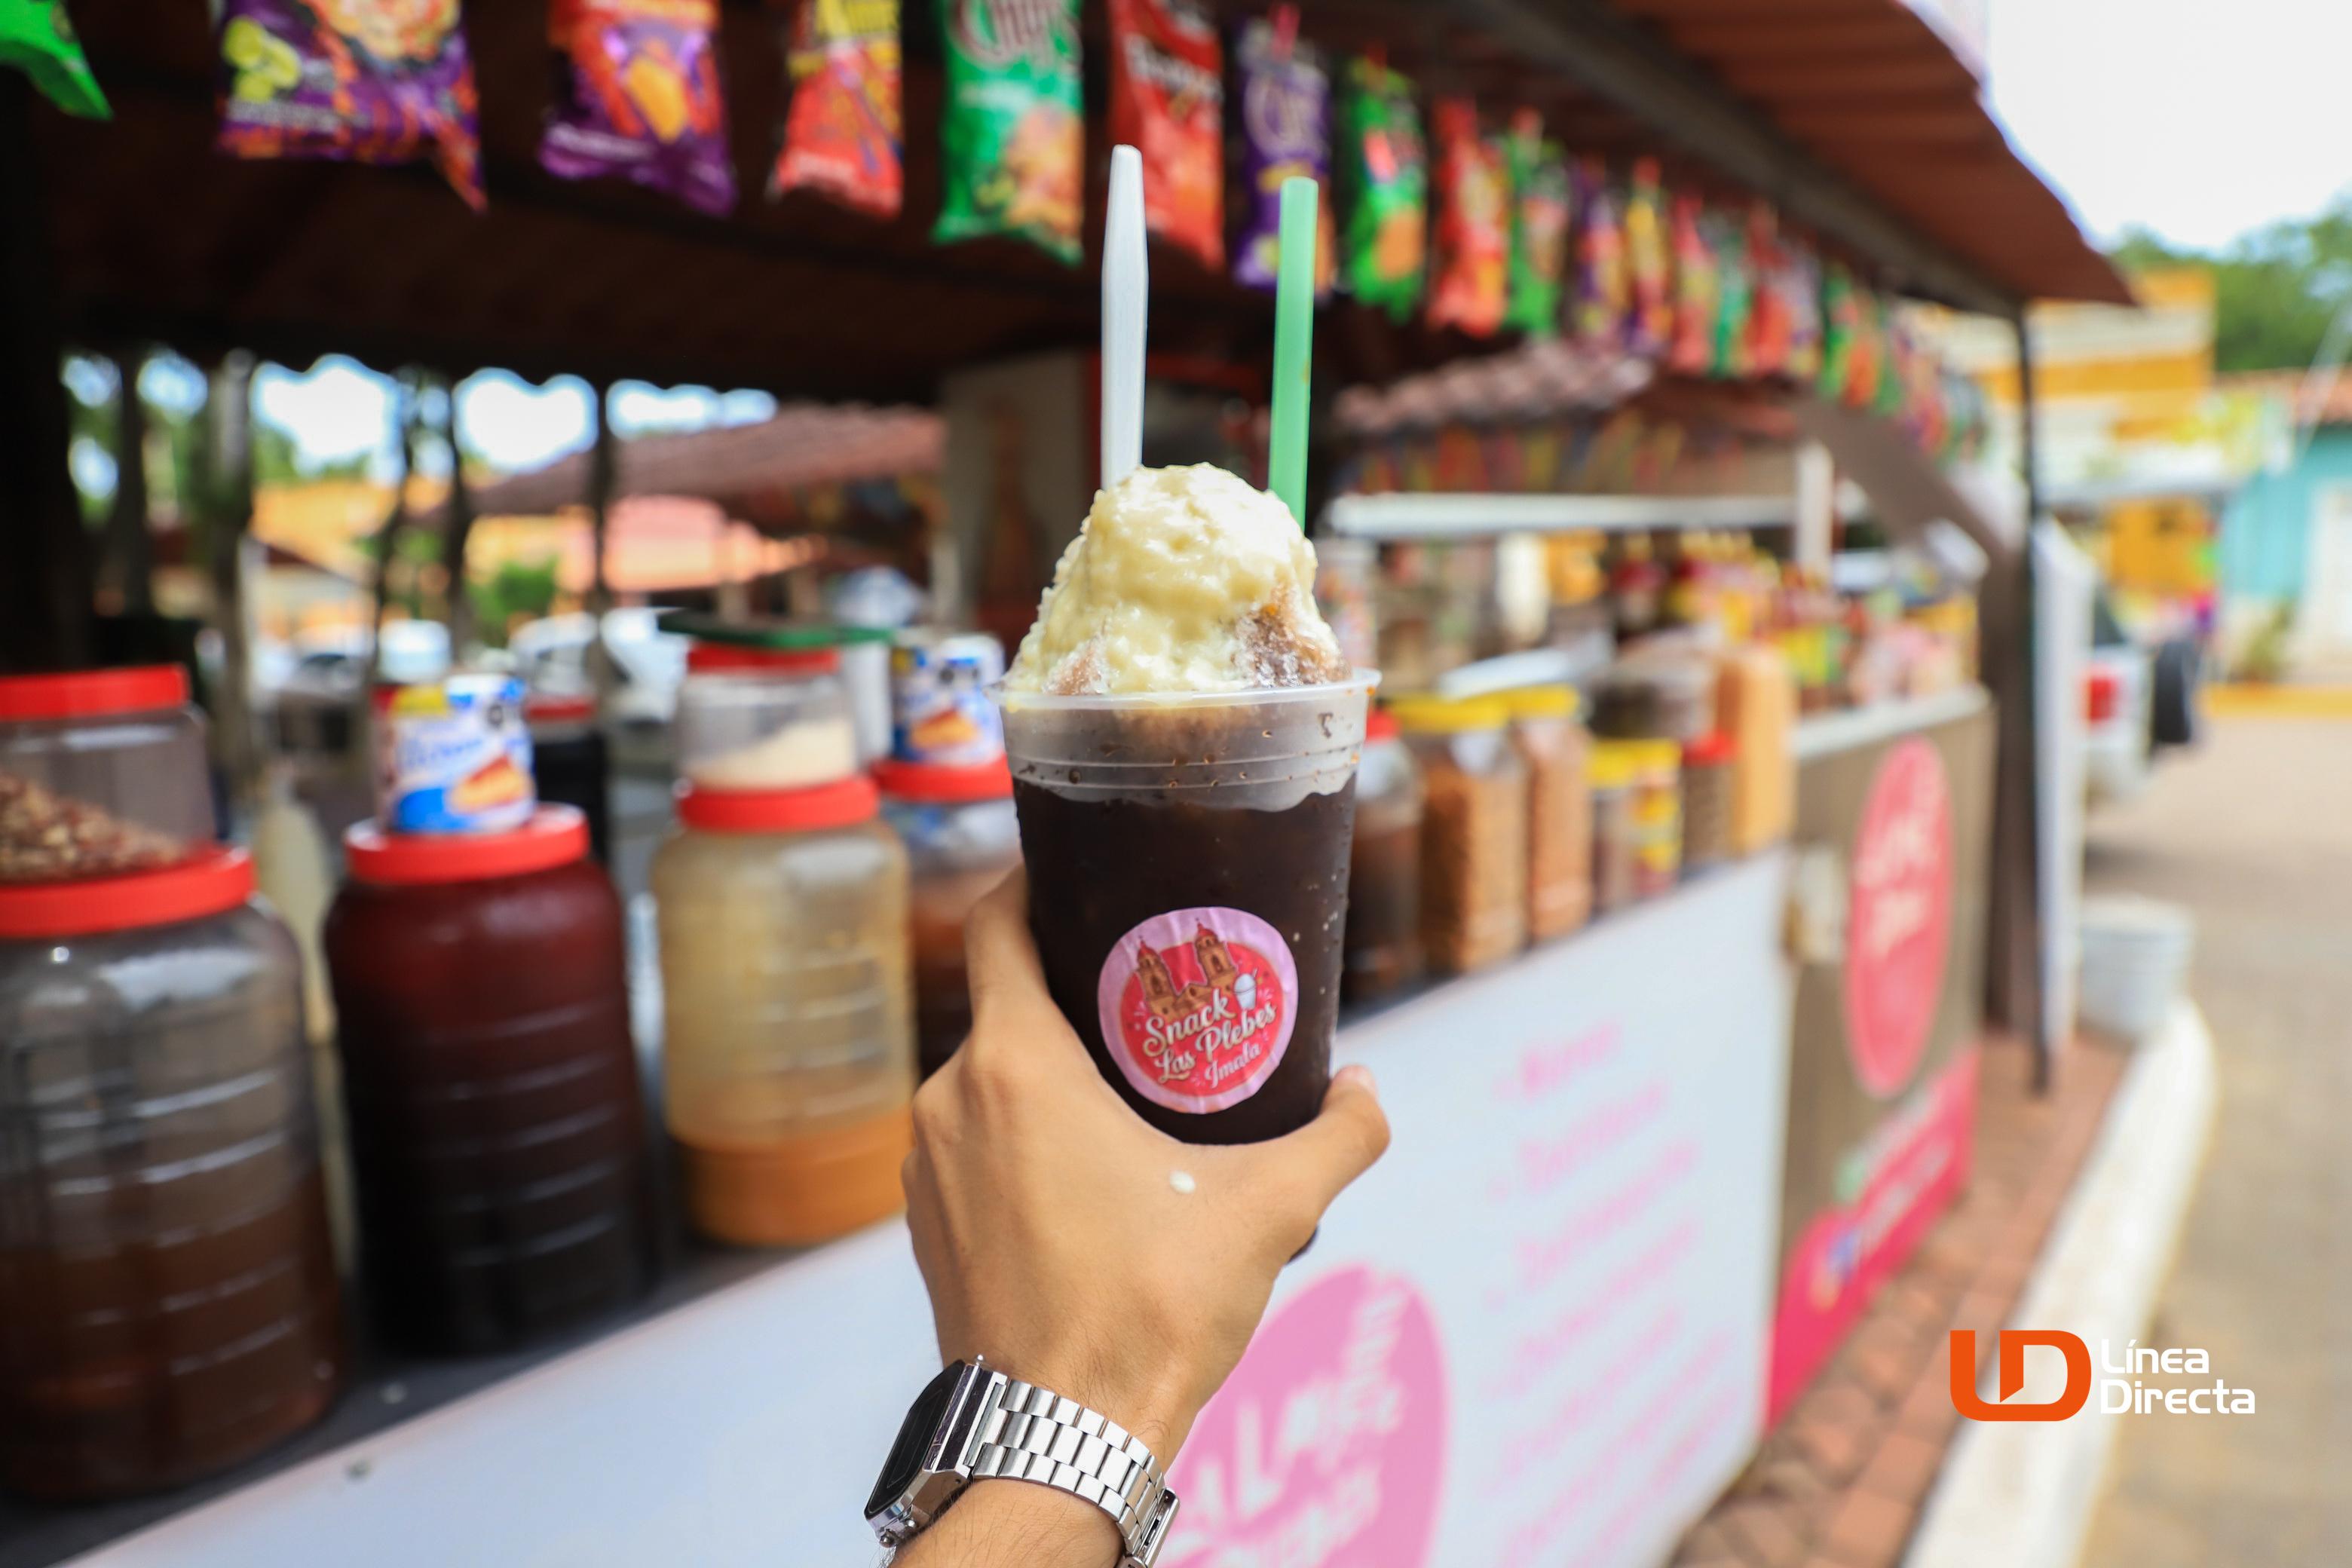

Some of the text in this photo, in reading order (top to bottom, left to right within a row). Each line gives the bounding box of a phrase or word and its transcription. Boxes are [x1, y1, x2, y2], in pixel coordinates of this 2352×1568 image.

[1143, 988, 1236, 1058] Snack
[1154, 1003, 1277, 1084] Las Plebes
